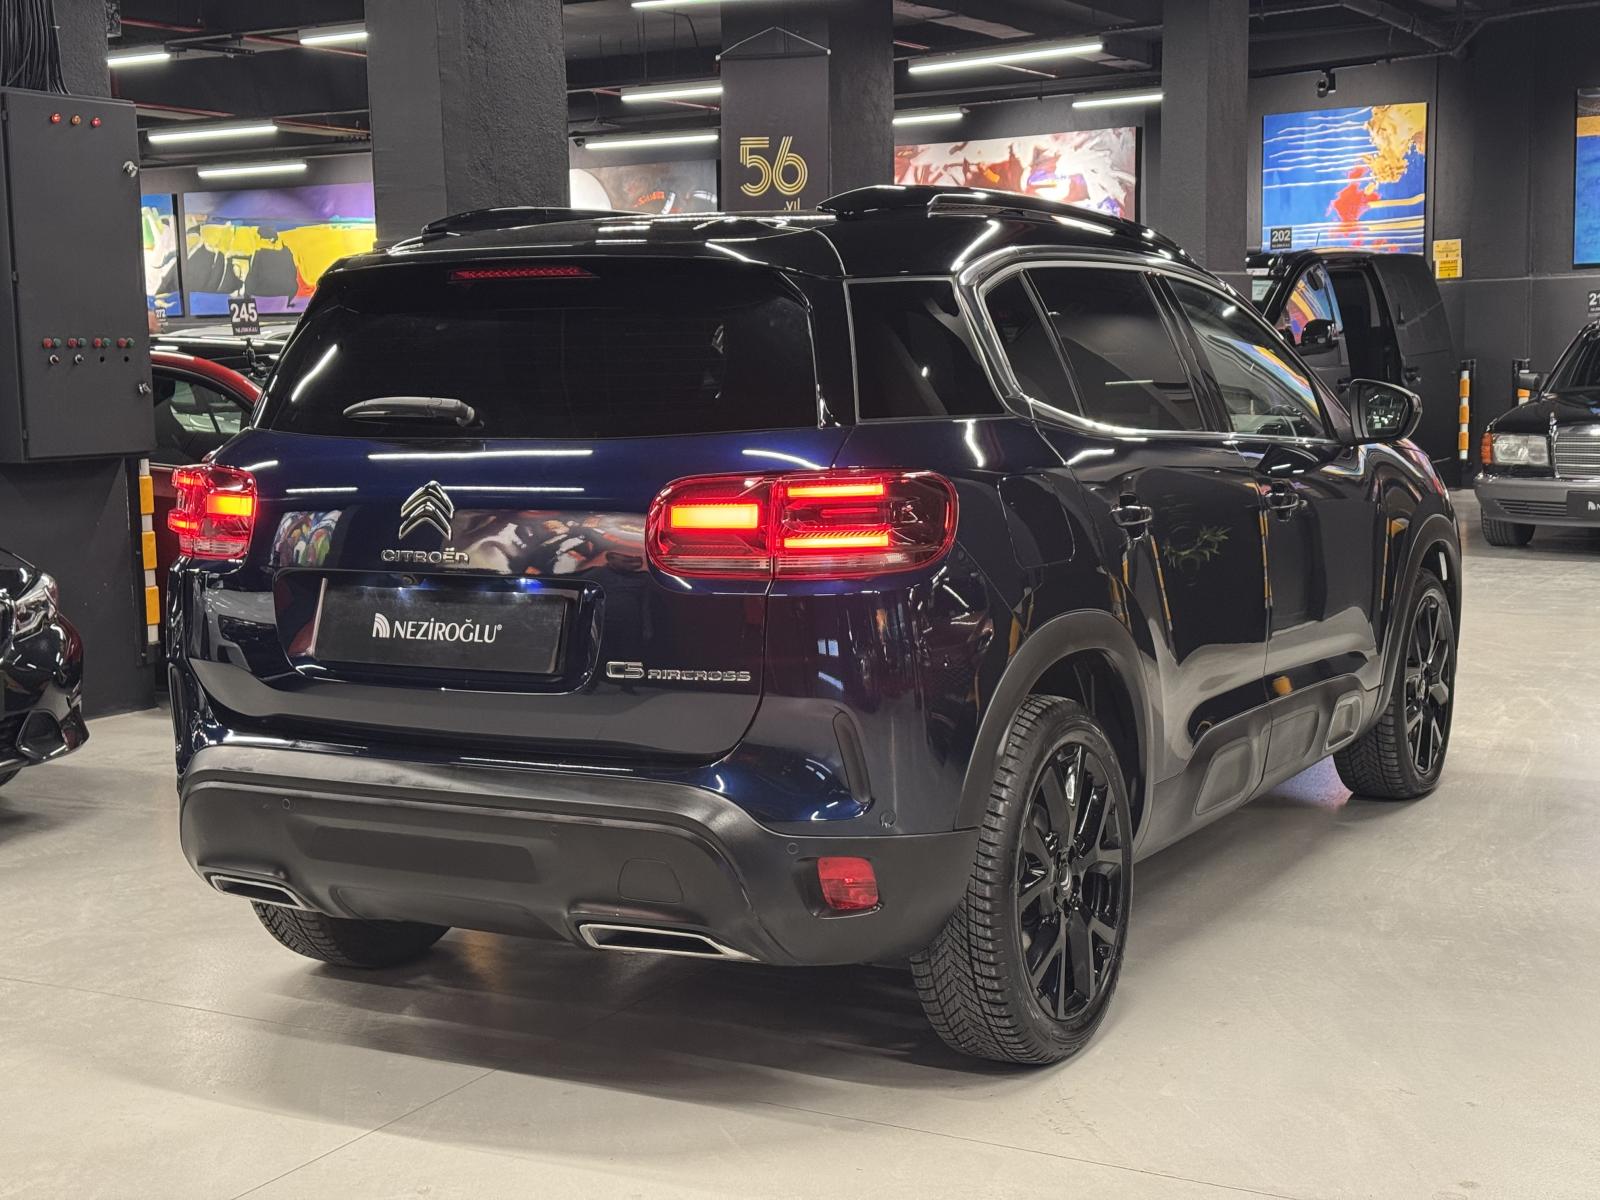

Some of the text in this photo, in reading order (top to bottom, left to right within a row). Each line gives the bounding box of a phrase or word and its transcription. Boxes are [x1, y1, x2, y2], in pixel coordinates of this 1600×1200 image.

[740, 135, 808, 196] 56
[1272, 230, 1291, 241] 202
[230, 302, 258, 323] 245
[606, 661, 751, 682] C5 AIRCROSS
